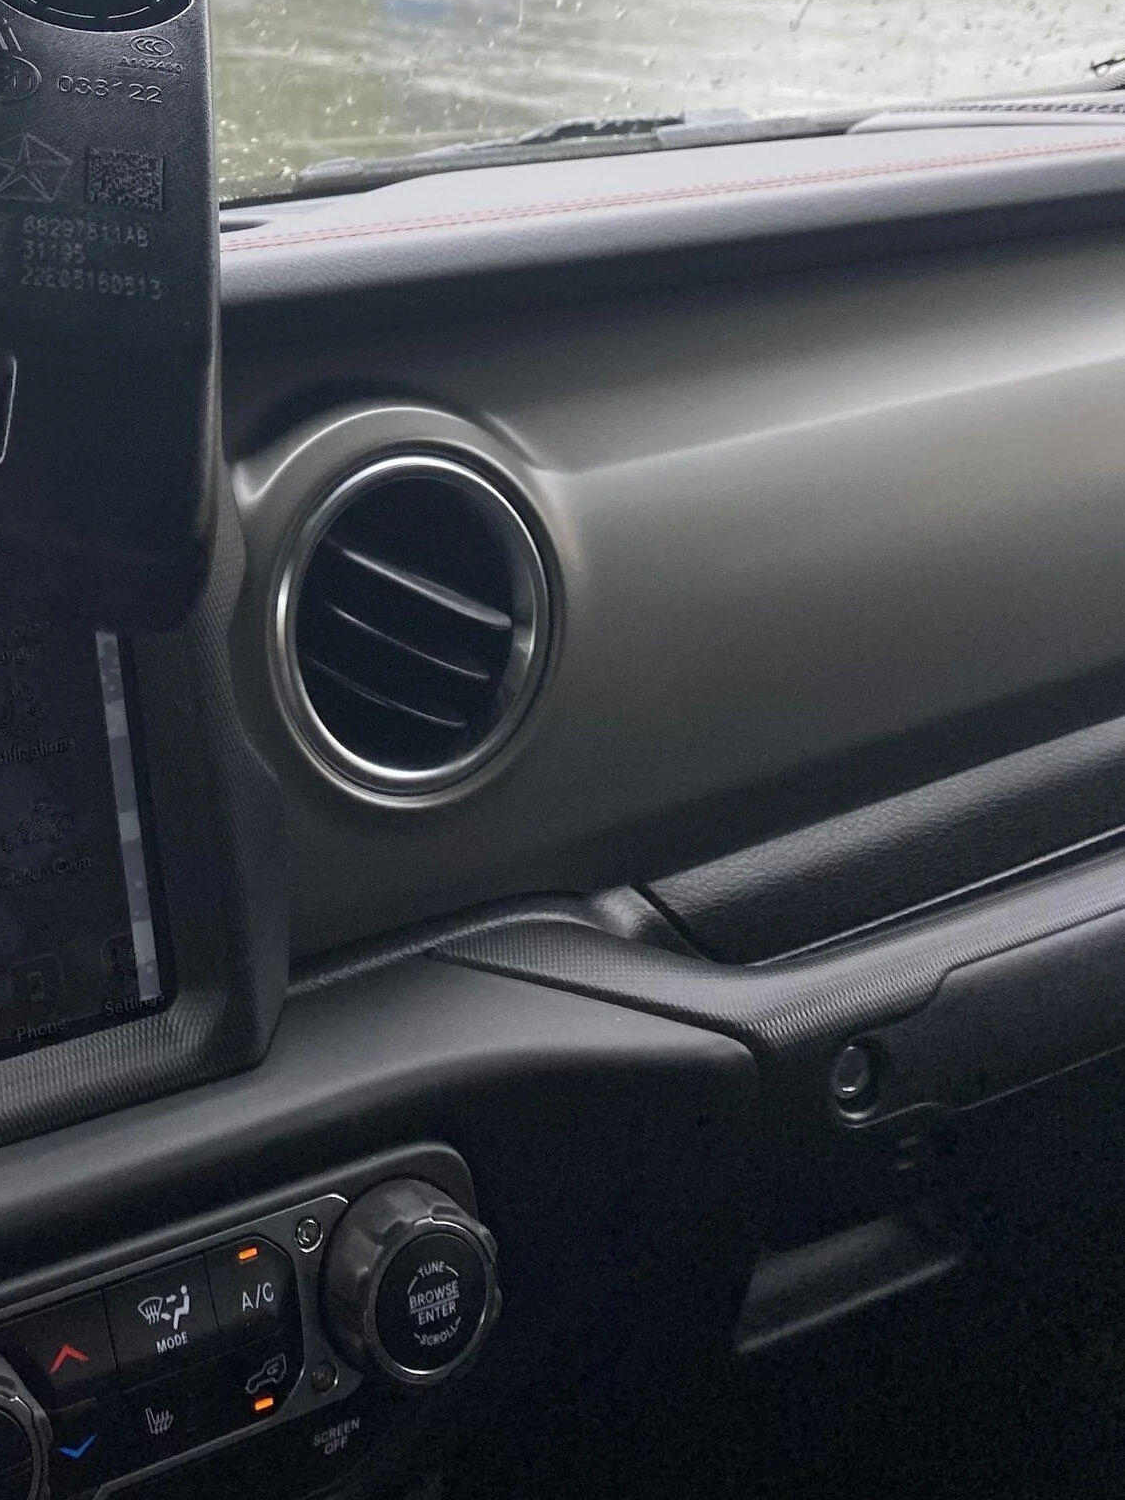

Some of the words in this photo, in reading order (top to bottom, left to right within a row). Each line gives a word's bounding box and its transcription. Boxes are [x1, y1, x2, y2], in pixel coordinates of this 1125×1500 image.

[16, 1018, 66, 1043] Phone
[417, 1261, 445, 1278] TUNE
[242, 1282, 274, 1311] A/C
[409, 1280, 459, 1309] BROWSE
[417, 1301, 456, 1326] ENTER
[156, 1331, 188, 1353] MODE
[420, 1324, 458, 1346] SCROLL
[314, 1417, 360, 1446] SCREEN
[324, 1435, 349, 1455] OFF
